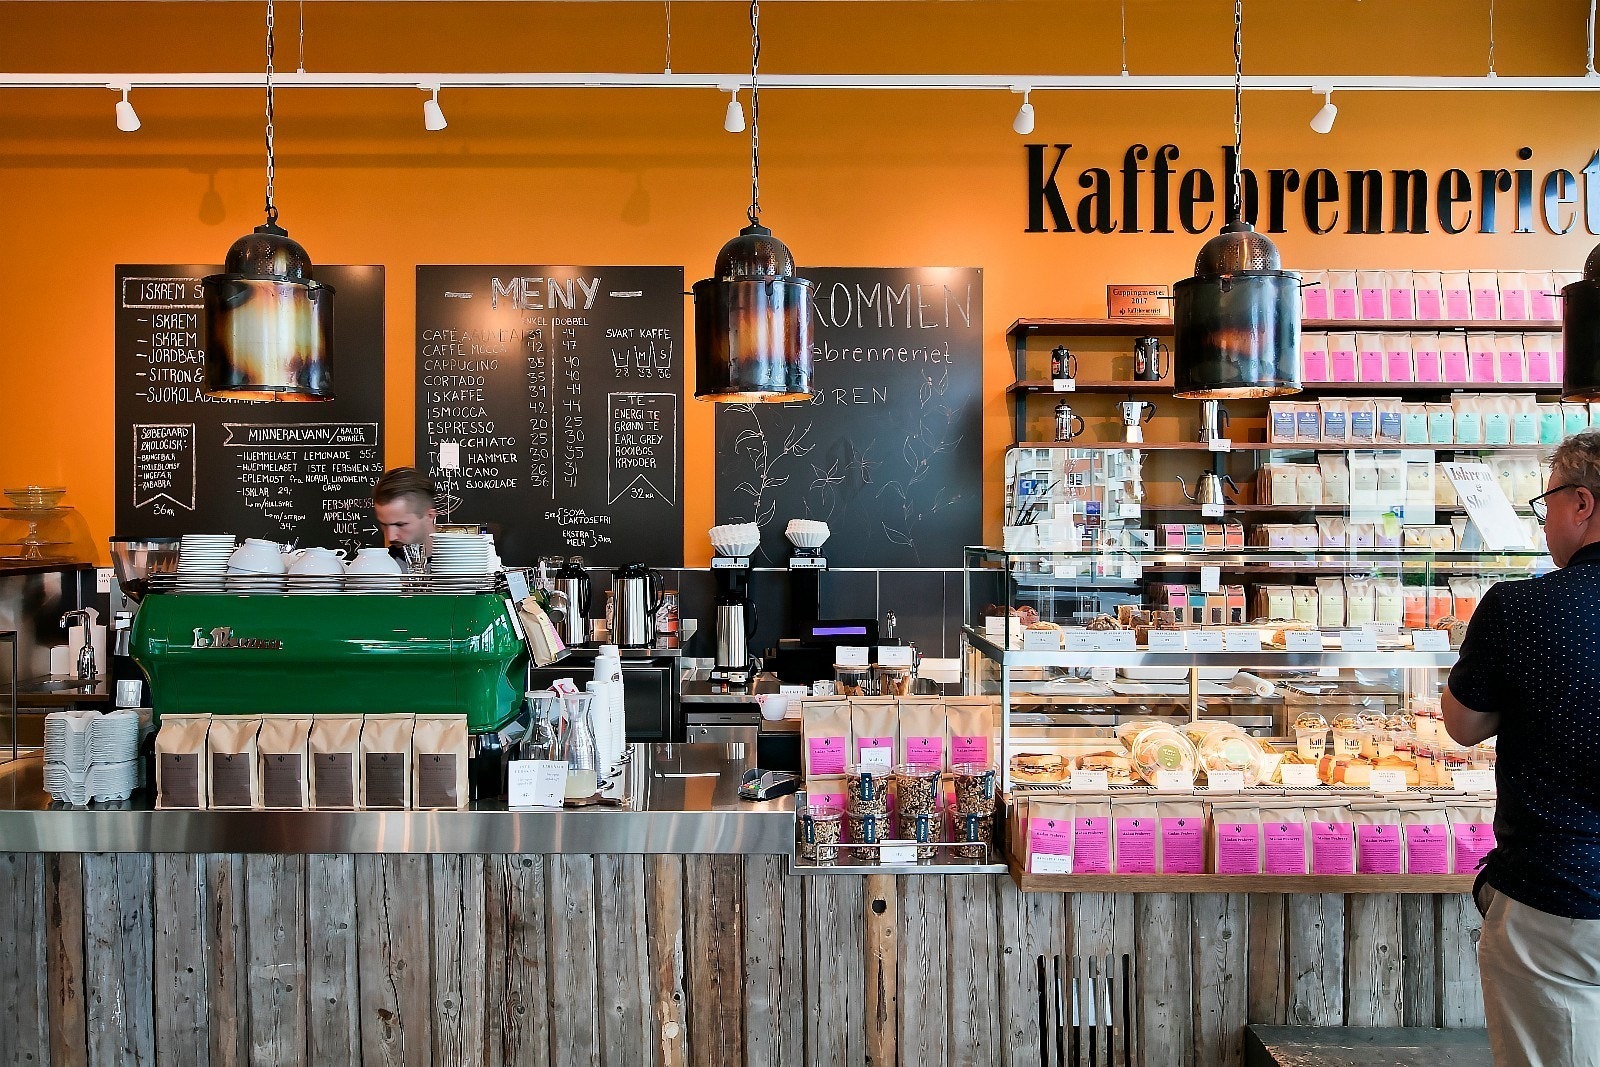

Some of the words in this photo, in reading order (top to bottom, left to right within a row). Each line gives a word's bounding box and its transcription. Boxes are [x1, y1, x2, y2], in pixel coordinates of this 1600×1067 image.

[141, 283, 185, 301] ISKREM
[491, 276, 602, 310] MENY
[812, 282, 971, 329] KOMMEN
[152, 314, 197, 329] ISKREM
[555, 317, 589, 326] DOBBEL
[152, 332, 197, 347] ISKREM
[605, 328, 635, 339] SVART
[640, 328, 672, 340] KAFFE
[618, 352, 625, 360] L
[638, 351, 646, 361] M
[660, 349, 667, 359] S
[812, 340, 953, 364] ebrenneriet
[424, 358, 498, 372] CAPPUCINO
[527, 357, 545, 369] 35
[563, 356, 580, 368] 40
[149, 368, 192, 383] SITRON
[423, 375, 485, 386] CORTADO
[565, 370, 580, 381] 40
[427, 388, 485, 403] ISKAFFE
[566, 383, 581, 394] 44
[427, 406, 488, 419] ISMOCCA
[614, 408, 644, 420] ENERGI
[647, 410, 660, 420] TE
[427, 421, 495, 435] ESPRESSO
[530, 419, 548, 430] 20
[564, 416, 583, 428] 25
[645, 421, 659, 431] TE
[530, 433, 548, 445] 25
[564, 430, 585, 444] 30
[614, 434, 638, 445] EARL
[639, 434, 664, 445] GREY
[303, 451, 351, 460] LEMONADE
[468, 451, 518, 465] HAMMER
[529, 448, 549, 462] 30
[615, 445, 654, 456] ROOIBOS
[615, 457, 657, 469] KRYDDER
[428, 466, 499, 478] AMERICANO
[242, 474, 285, 484] EPLEMOST
[465, 478, 518, 490] SJOKOLADE
[563, 508, 586, 517] SOYA
[333, 522, 359, 535] JUICE
[562, 529, 590, 539] EKSTRA
[566, 538, 586, 547] MELK
